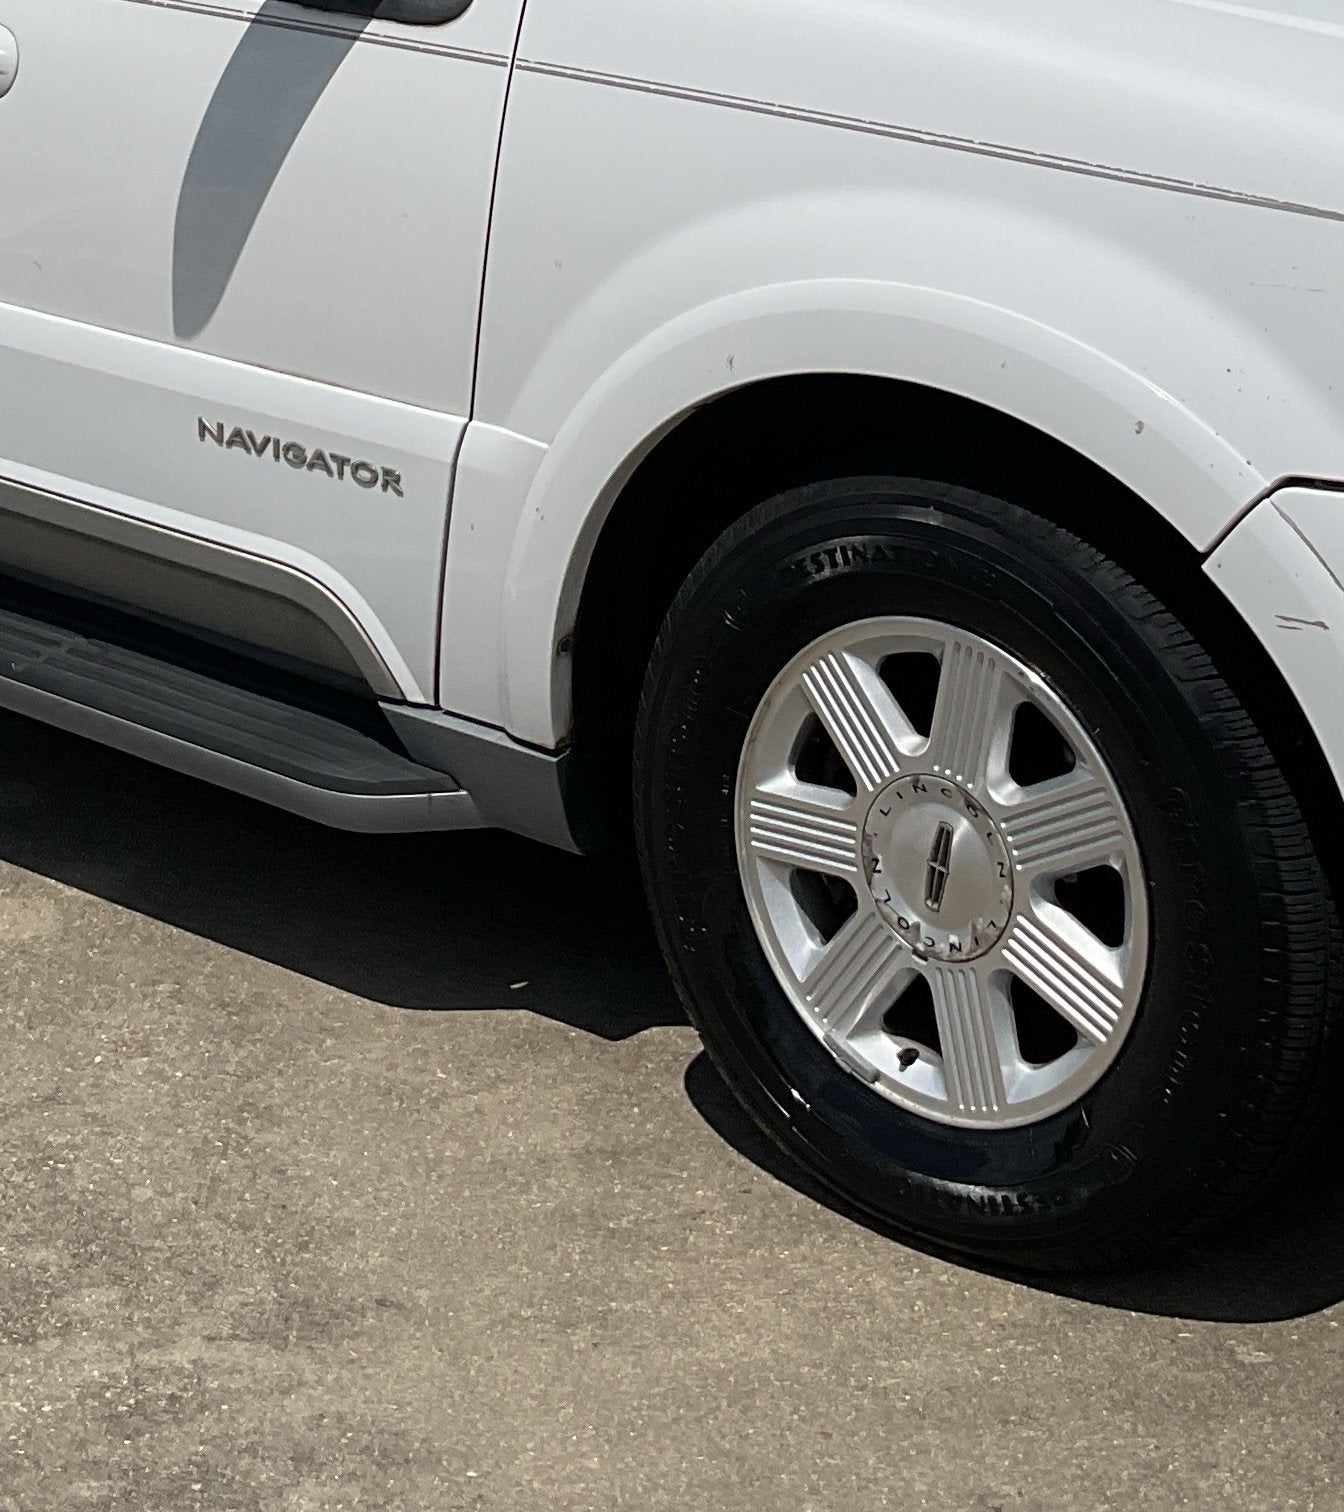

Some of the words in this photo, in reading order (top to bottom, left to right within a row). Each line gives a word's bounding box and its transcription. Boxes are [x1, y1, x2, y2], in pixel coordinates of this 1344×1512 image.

[197, 416, 404, 498] NAVIGATOR
[878, 783, 1006, 879] LINCOLN
[870, 858, 998, 954] LINCOLN
